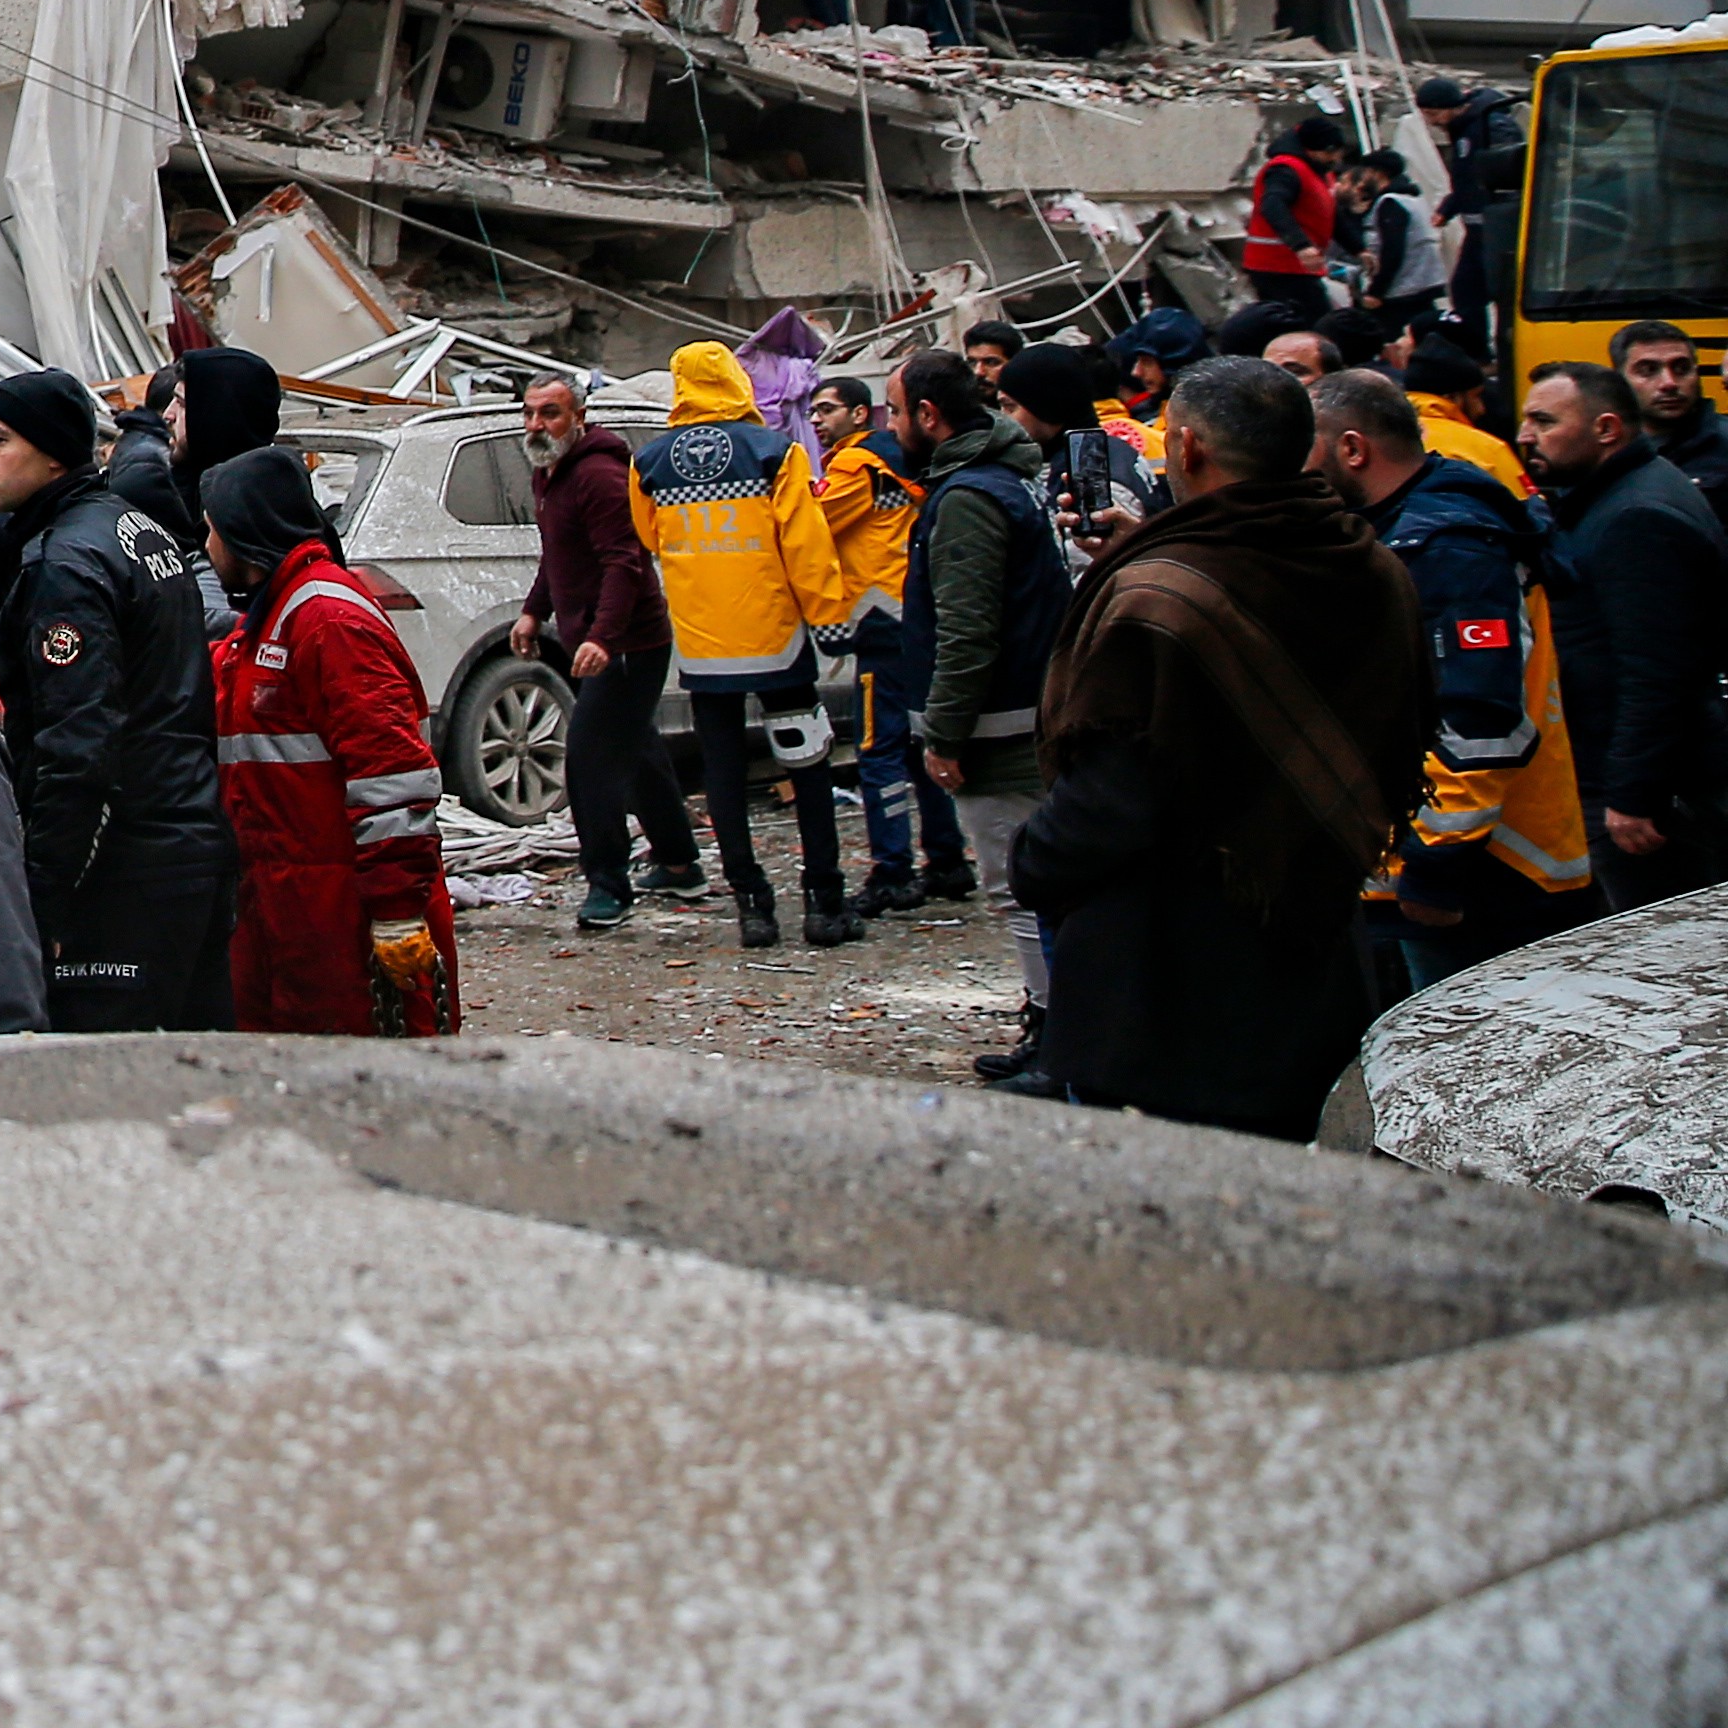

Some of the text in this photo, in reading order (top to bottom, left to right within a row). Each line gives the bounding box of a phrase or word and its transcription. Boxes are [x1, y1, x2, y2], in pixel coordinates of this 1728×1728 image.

[503, 41, 531, 126] BEKO
[676, 504, 739, 533] 112
[90, 962, 139, 978] KUVVET
